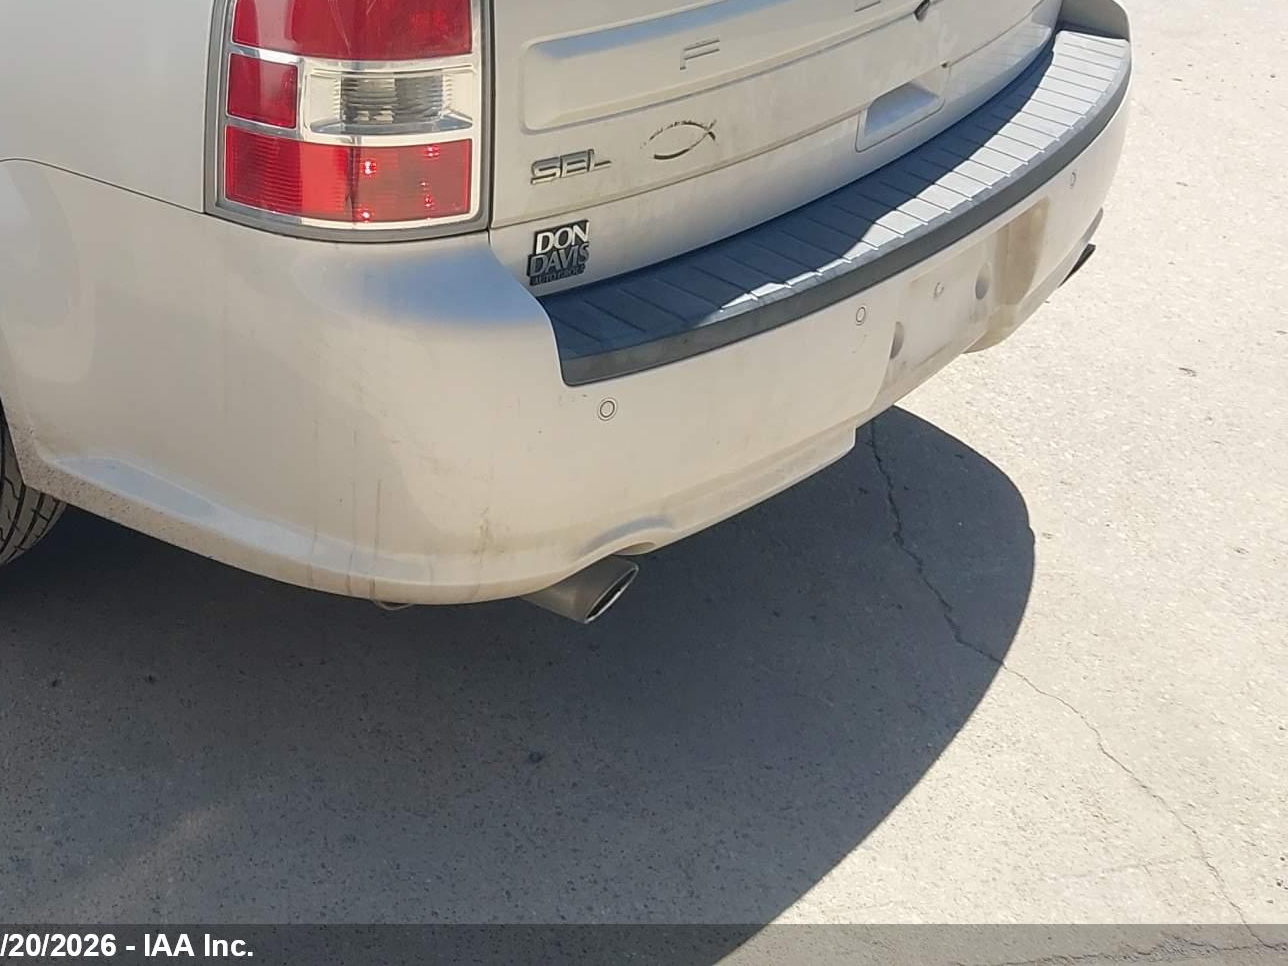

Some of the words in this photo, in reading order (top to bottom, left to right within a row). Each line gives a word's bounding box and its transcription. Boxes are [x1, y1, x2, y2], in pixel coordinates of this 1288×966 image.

[530, 148, 612, 185] SEL
[535, 221, 590, 255] DON
[529, 243, 590, 277] DAVIS
